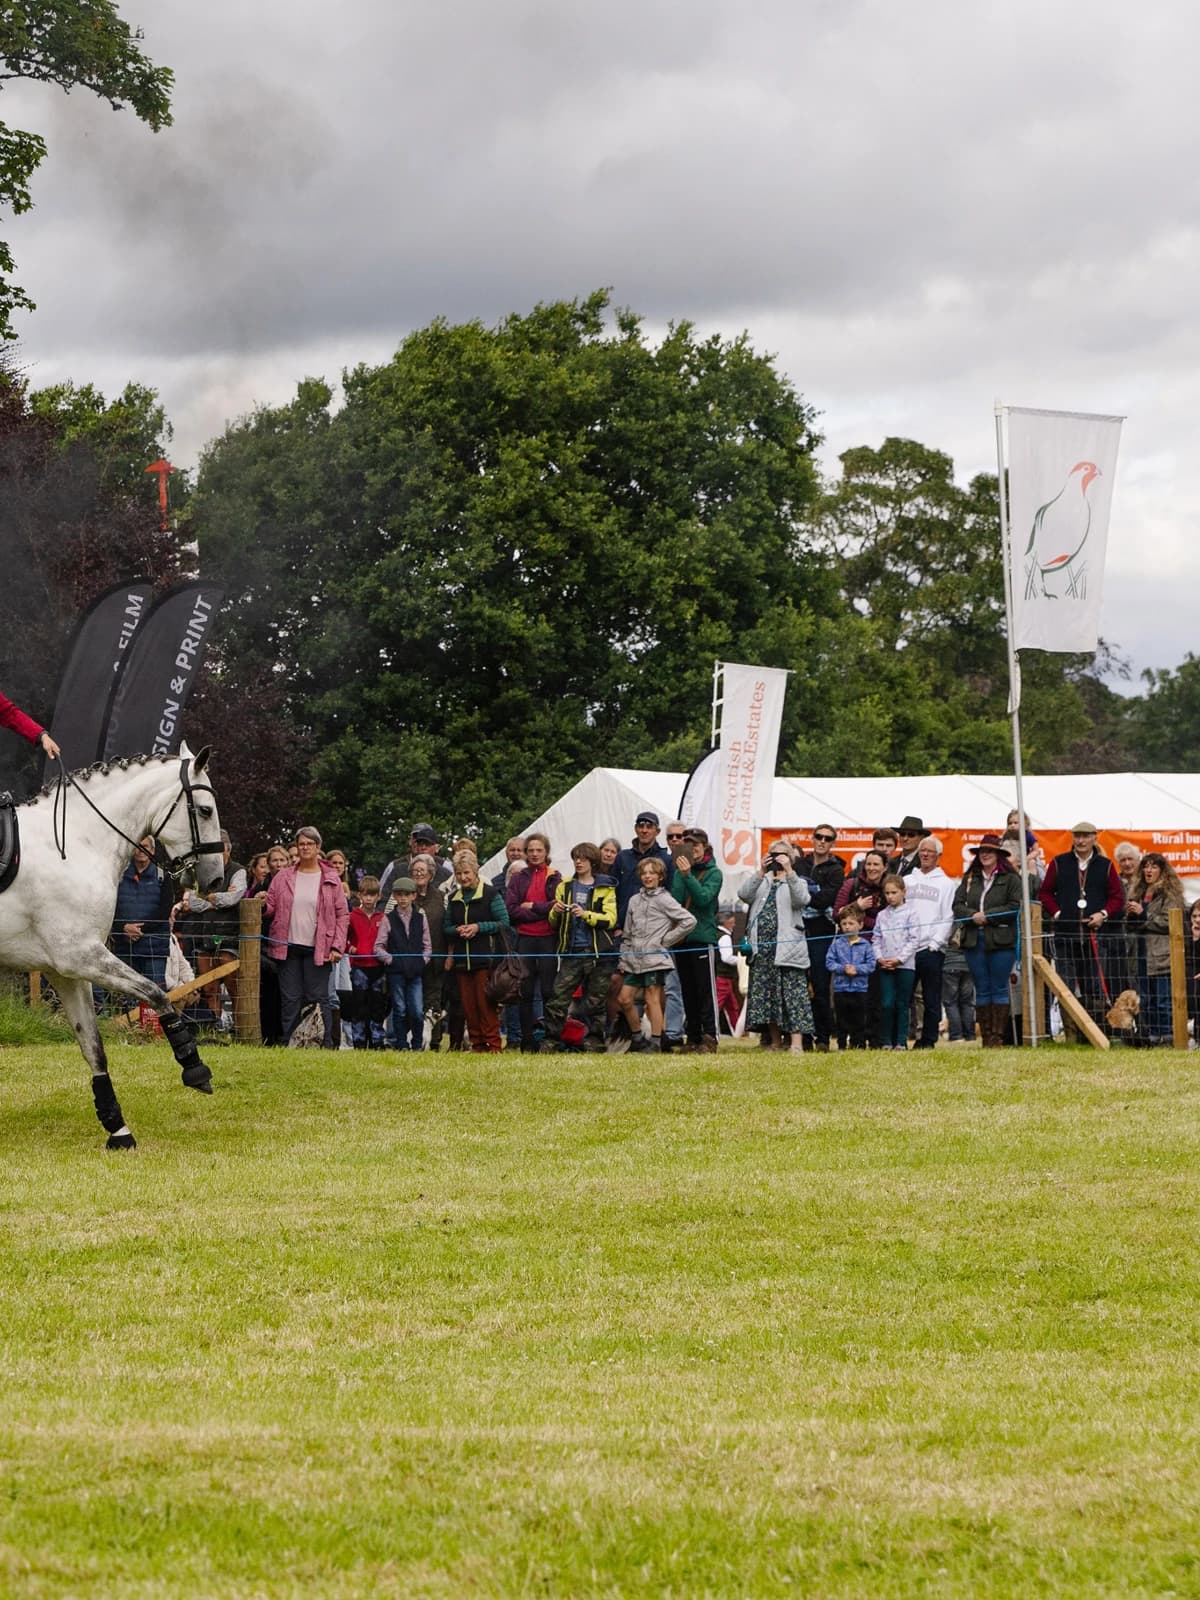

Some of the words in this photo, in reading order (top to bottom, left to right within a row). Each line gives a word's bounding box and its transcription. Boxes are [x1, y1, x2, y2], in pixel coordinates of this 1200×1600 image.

[119, 594, 144, 649] FILM
[175, 594, 213, 671] PRINT
[170, 676, 187, 694] &
[722, 740, 742, 823] Scottish
[1152, 832, 1183, 845] Rural
